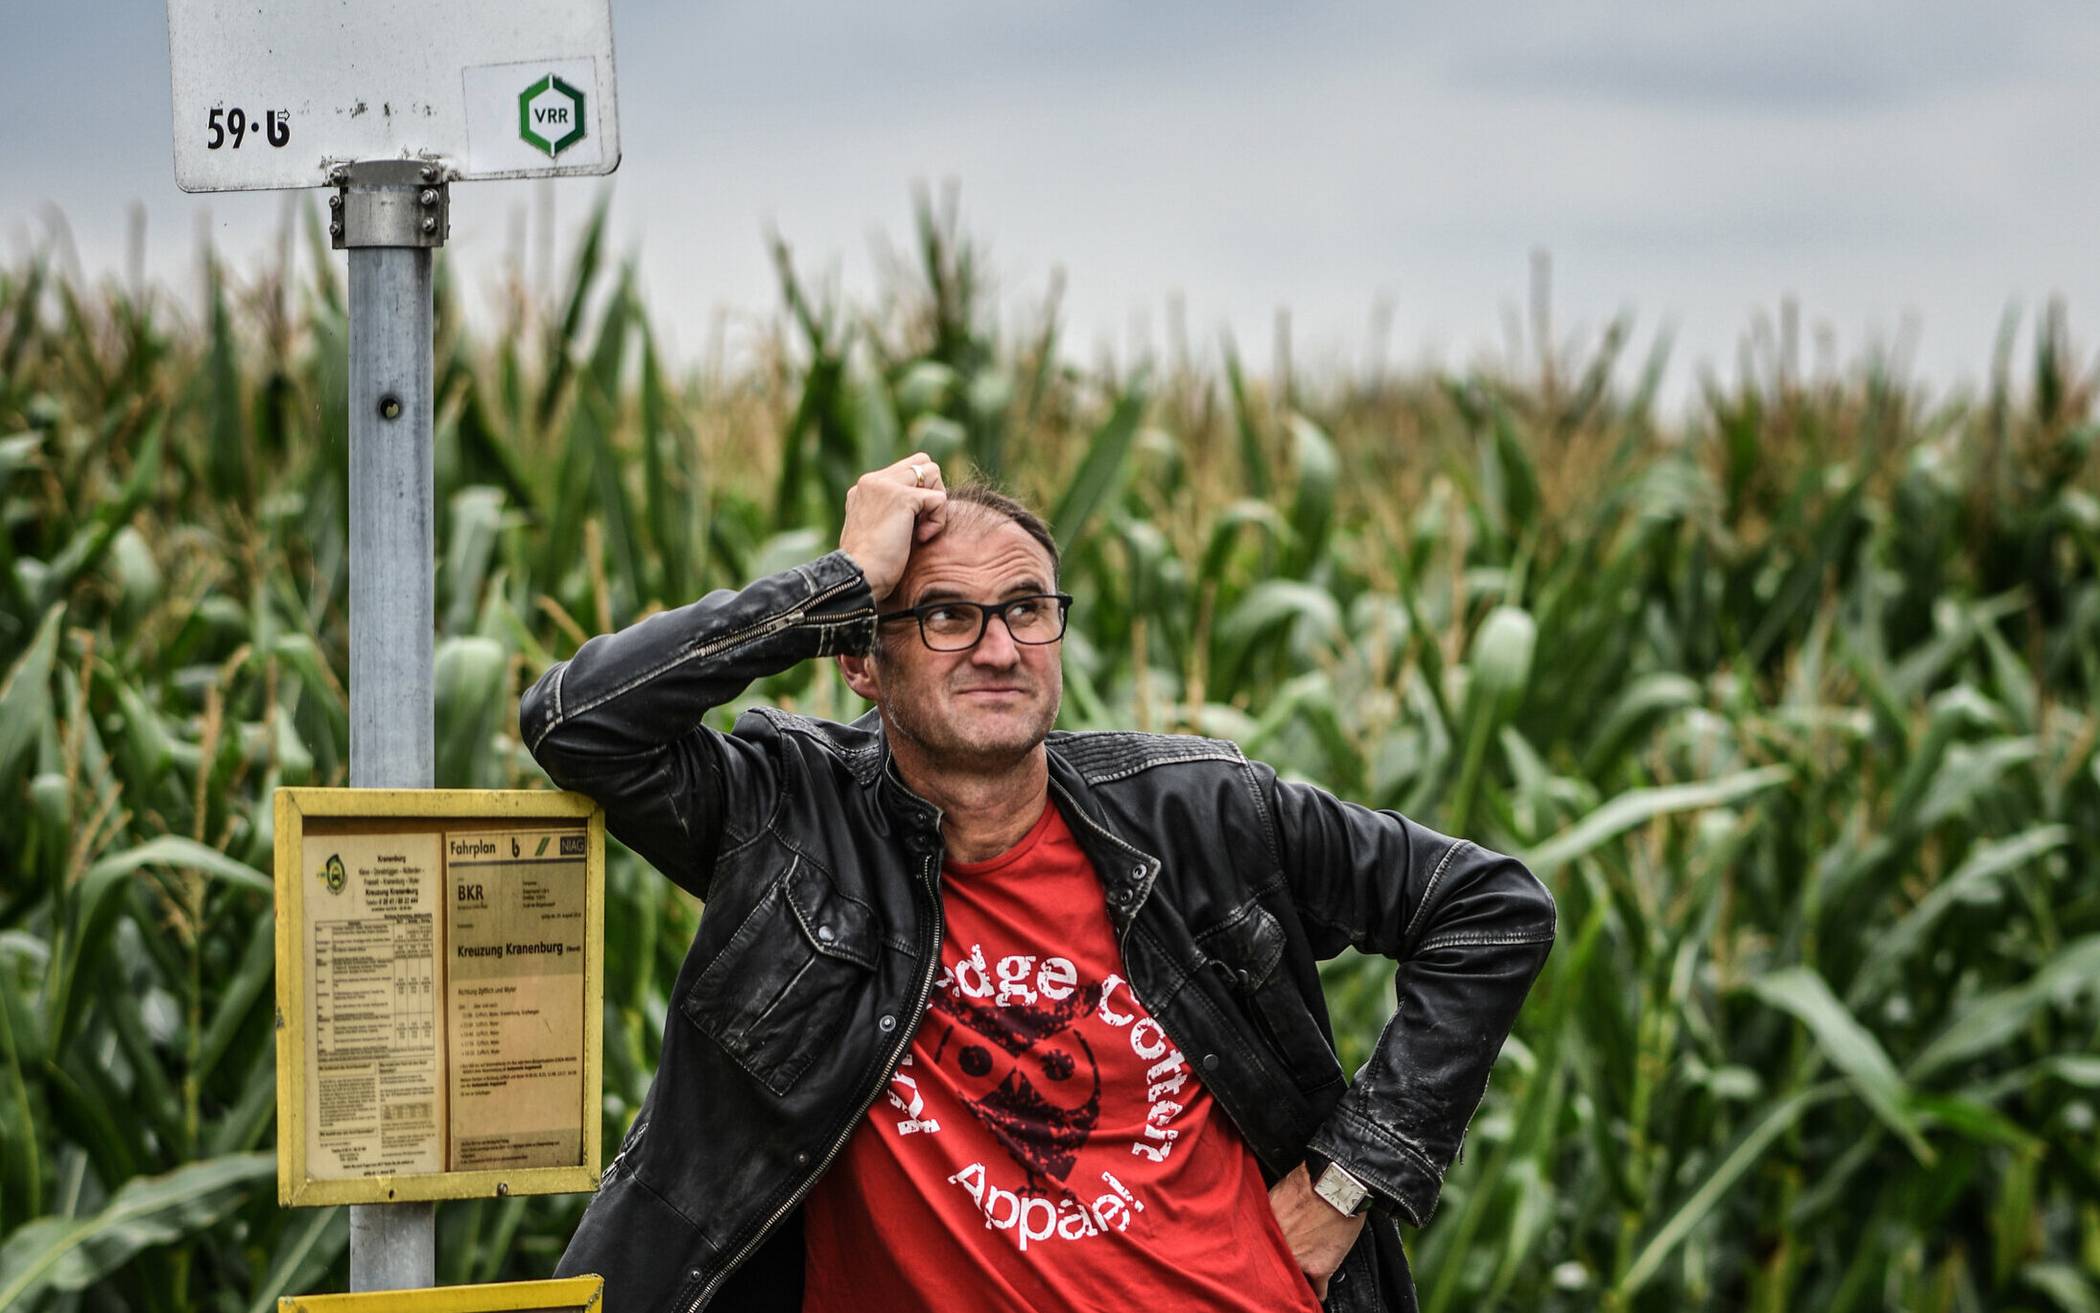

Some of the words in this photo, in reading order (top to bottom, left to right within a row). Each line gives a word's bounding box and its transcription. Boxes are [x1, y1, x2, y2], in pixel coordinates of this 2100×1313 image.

[534, 108, 568, 123] VRR
[450, 839, 496, 857] Fahrplan
[561, 838, 585, 852] NIAG
[458, 884, 484, 901] BKR
[457, 945, 503, 959] Kreuzung
[505, 941, 563, 955] Kranenburg
